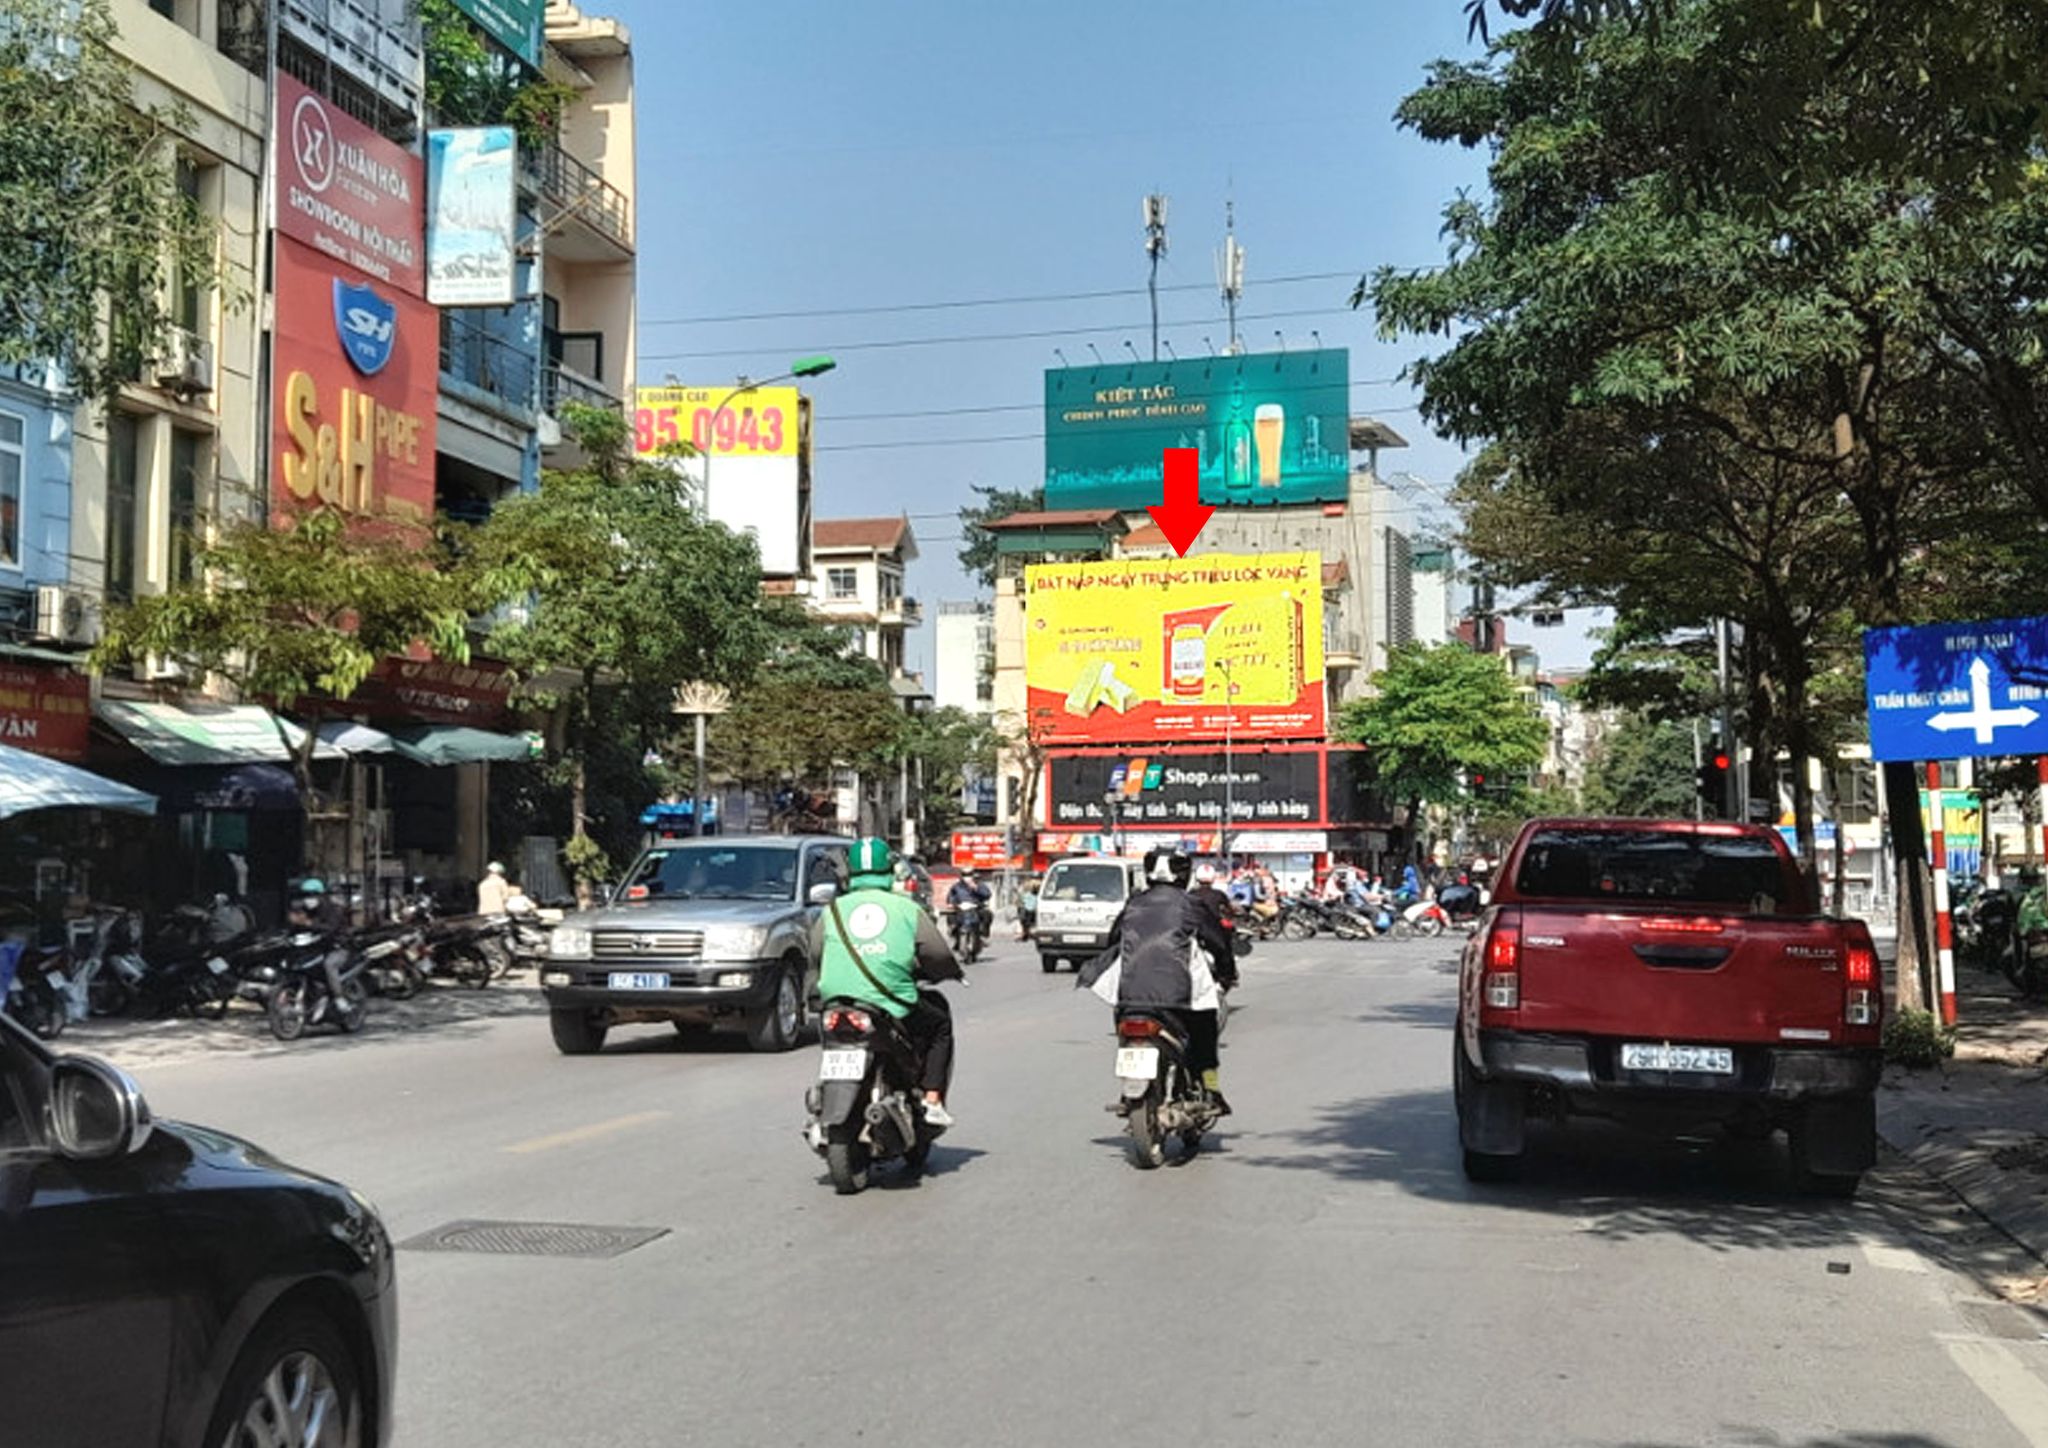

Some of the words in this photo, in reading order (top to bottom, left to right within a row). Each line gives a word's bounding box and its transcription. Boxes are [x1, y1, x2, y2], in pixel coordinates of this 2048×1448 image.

[290, 186, 361, 240] SHOWROOM
[283, 370, 374, 516] S&H
[375, 404, 424, 465] PIPE
